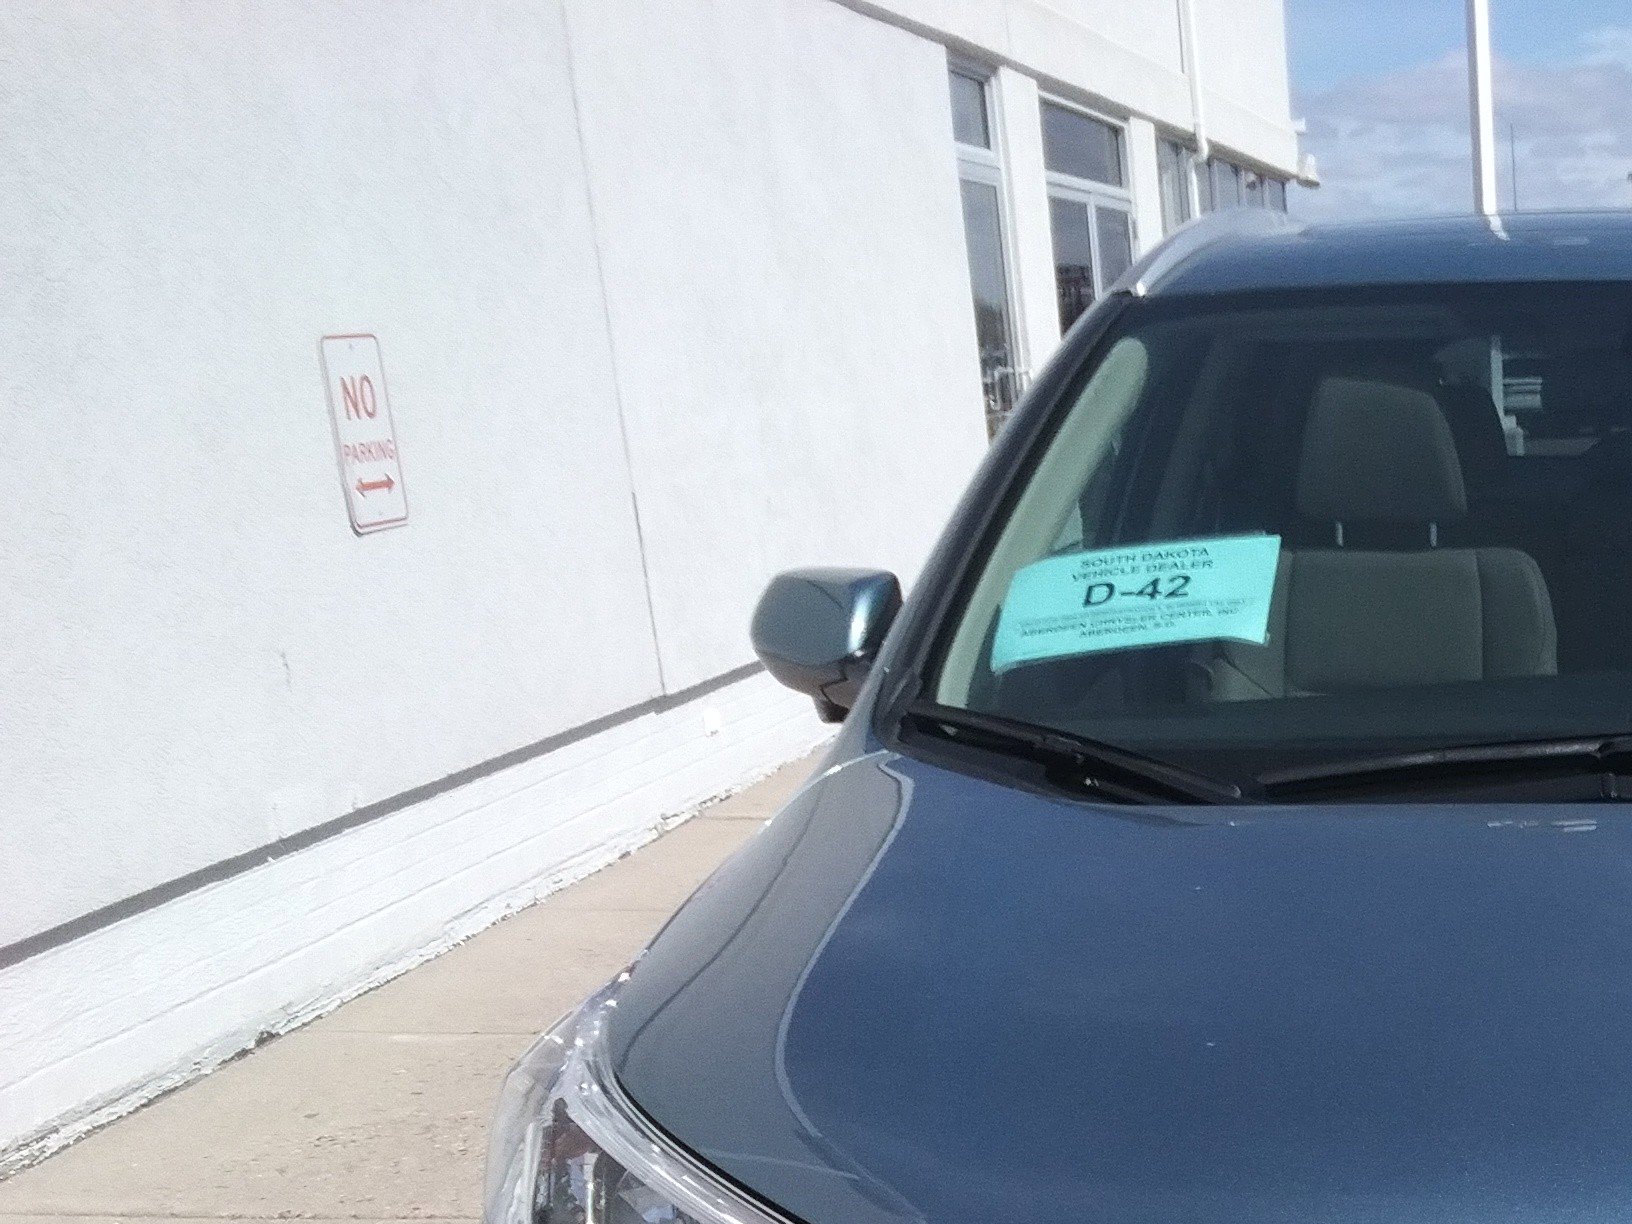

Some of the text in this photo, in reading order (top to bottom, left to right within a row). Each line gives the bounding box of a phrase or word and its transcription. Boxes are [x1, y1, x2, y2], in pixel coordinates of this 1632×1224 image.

[340, 374, 377, 421] NO
[343, 438, 394, 463] PARKING
[1072, 559, 1214, 581] VEHICLE DEALER
[1081, 547, 1210, 569] SOUTH DAKOTA
[1083, 575, 1191, 608] D-42
